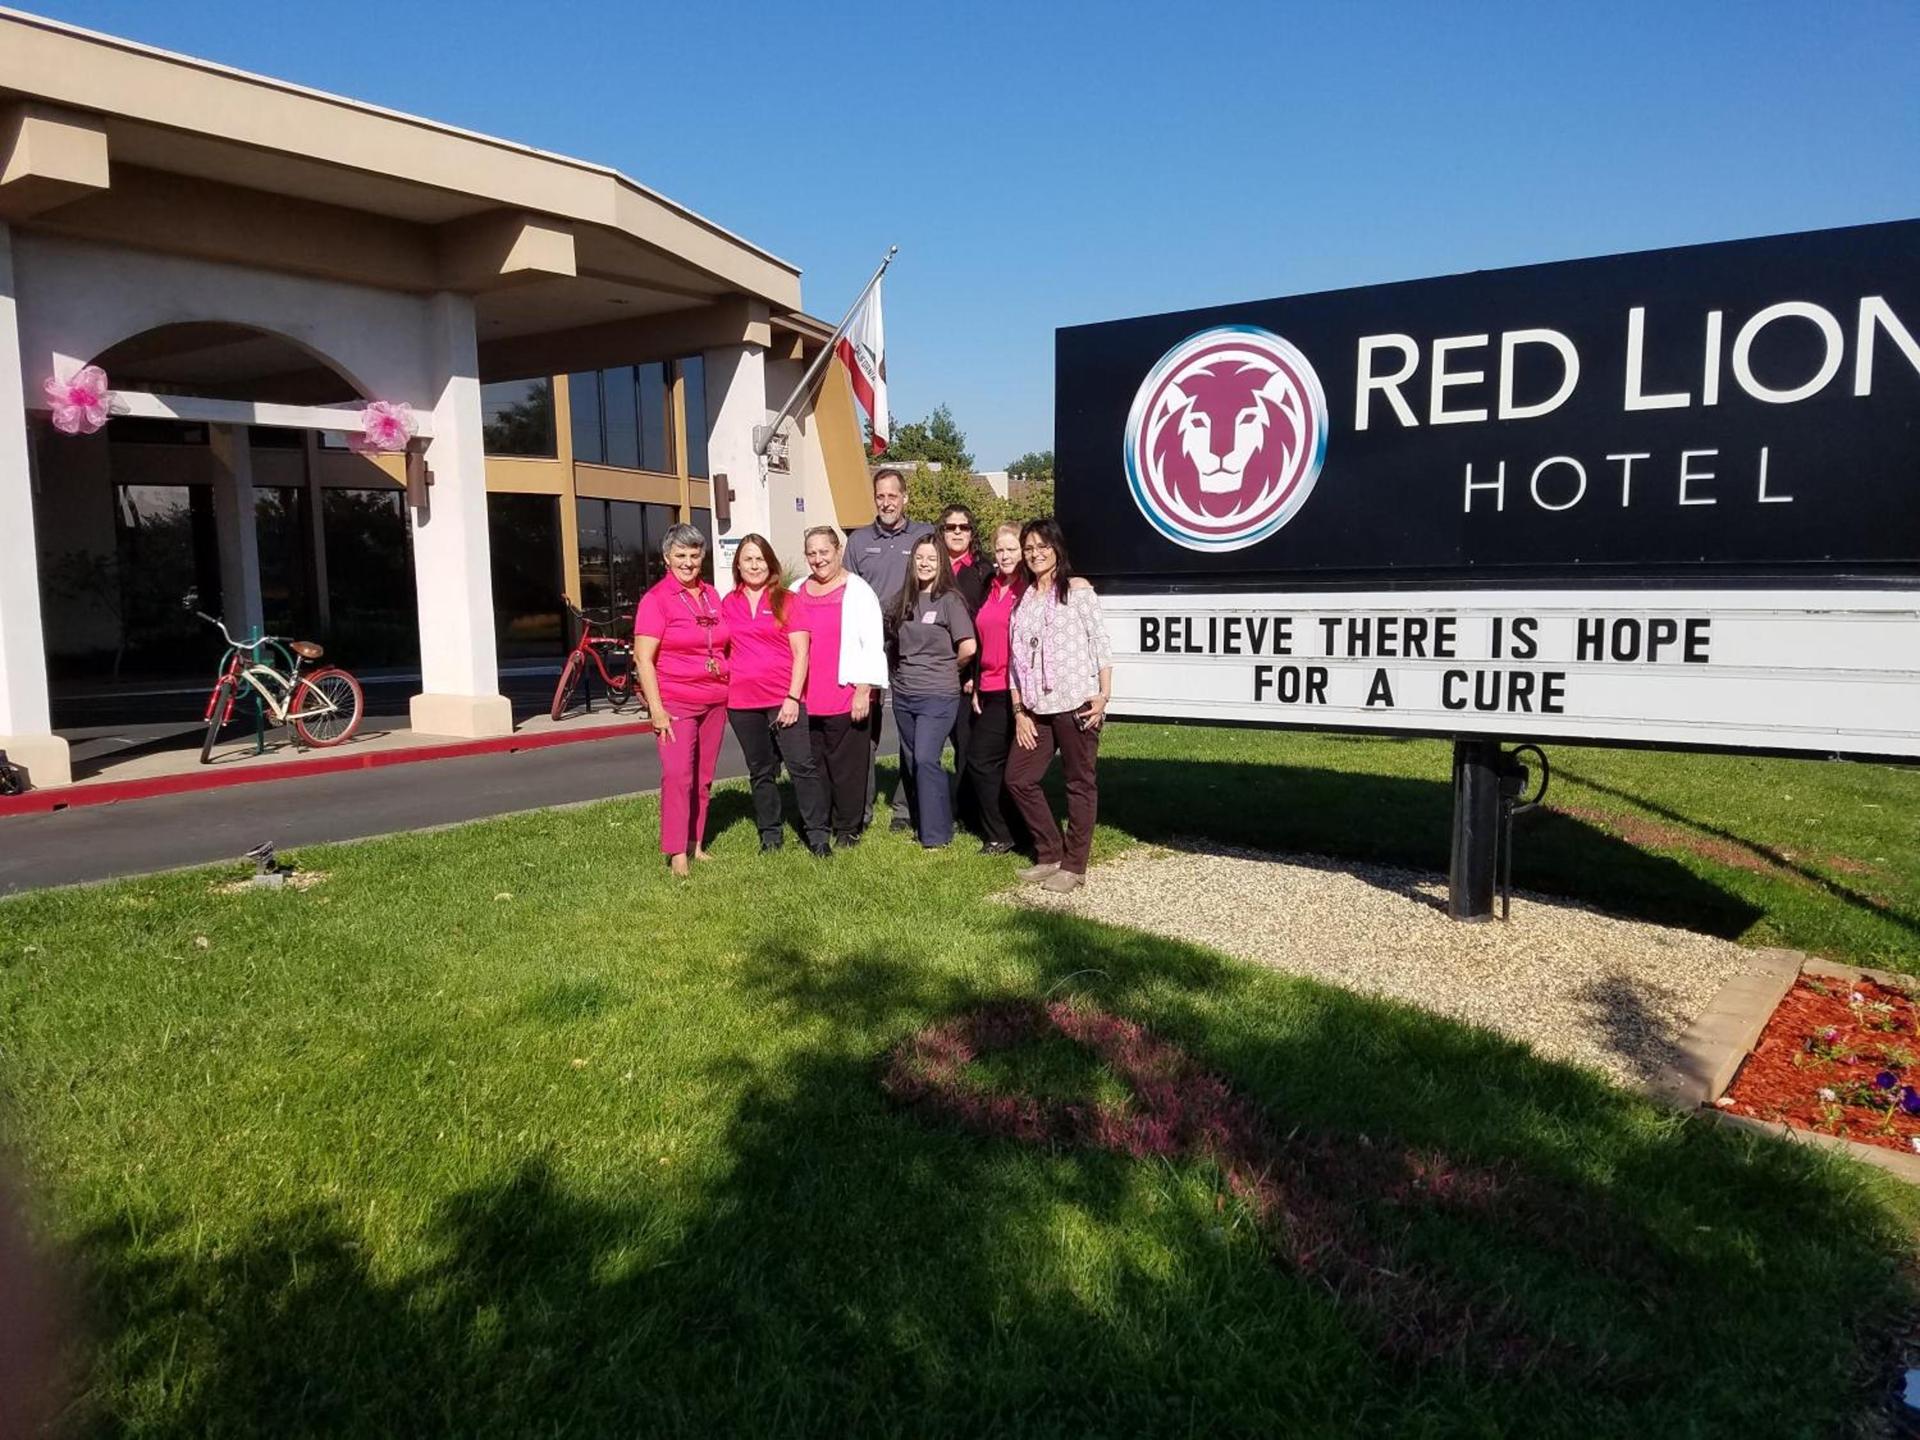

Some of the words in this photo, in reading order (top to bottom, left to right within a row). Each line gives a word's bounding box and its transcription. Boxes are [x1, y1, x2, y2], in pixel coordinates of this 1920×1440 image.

[1354, 328, 1580, 431] RED
[1464, 446, 1794, 513] HOTEL
[1140, 616, 1293, 655] BELIEVE
[1318, 616, 1457, 658] THERE
[1491, 617, 1538, 660] IS
[1576, 617, 1711, 664] HOPE
[1254, 665, 1328, 705] FOR
[1365, 667, 1395, 708] A
[1442, 669, 1566, 714] CURE
